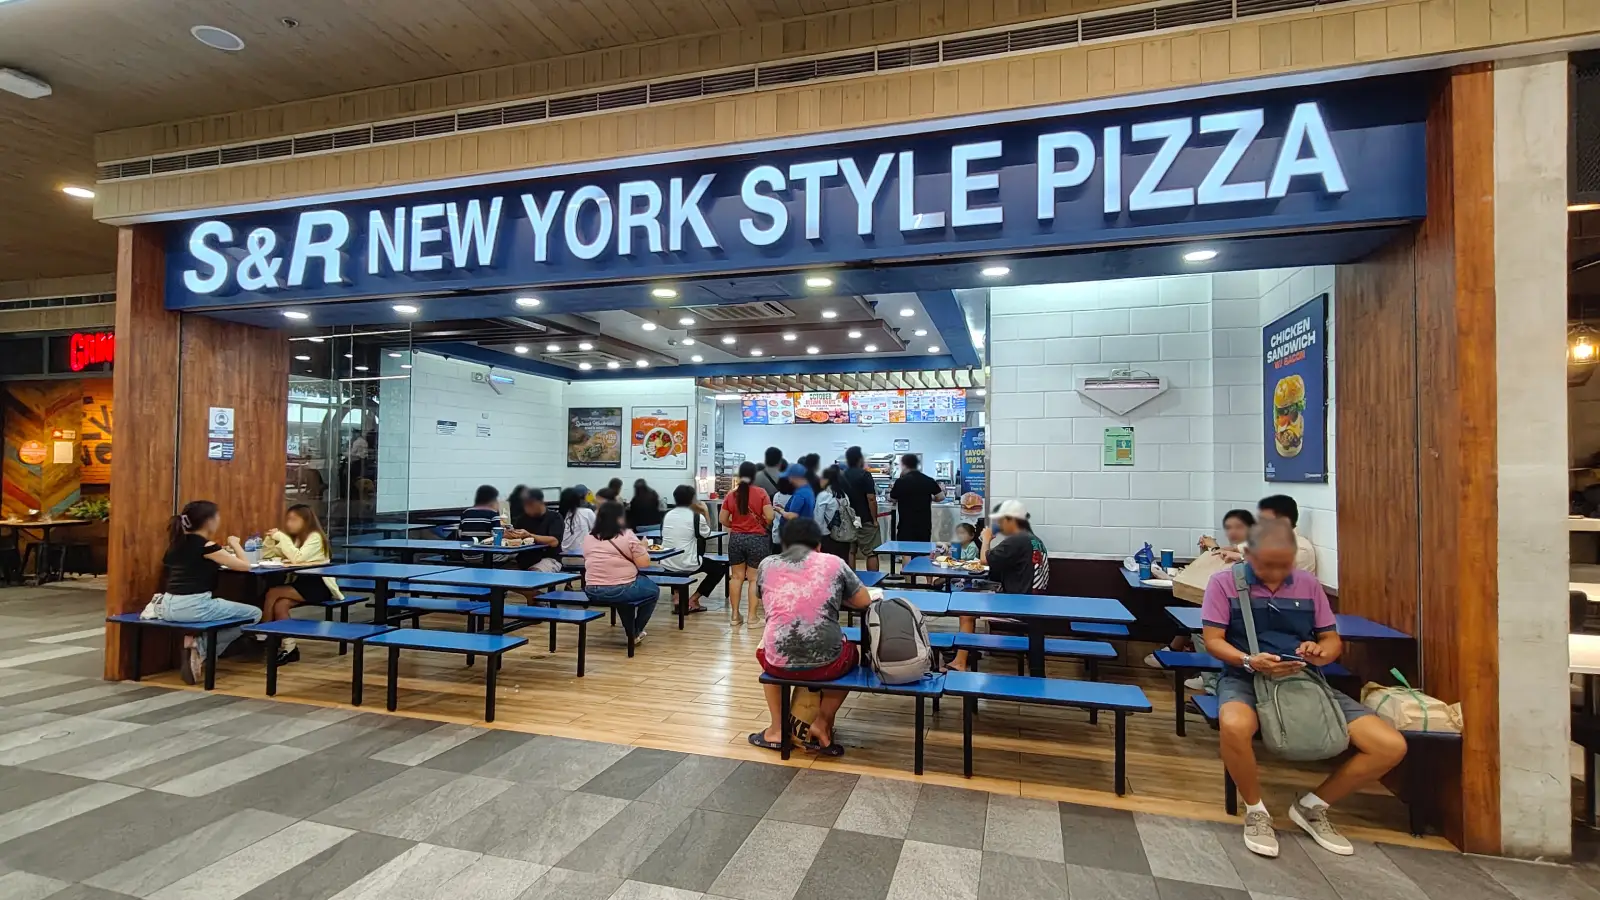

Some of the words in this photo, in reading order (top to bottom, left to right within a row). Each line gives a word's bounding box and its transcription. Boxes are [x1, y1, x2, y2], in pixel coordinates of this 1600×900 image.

[183, 209, 350, 294] S&R
[368, 196, 504, 275] NEW
[521, 173, 720, 262] YORK
[739, 140, 1004, 246] STYLE
[1037, 102, 1350, 220] PIZZA
[1266, 330, 1316, 364] SANDWICH
[1270, 316, 1311, 348] CHICKEN
